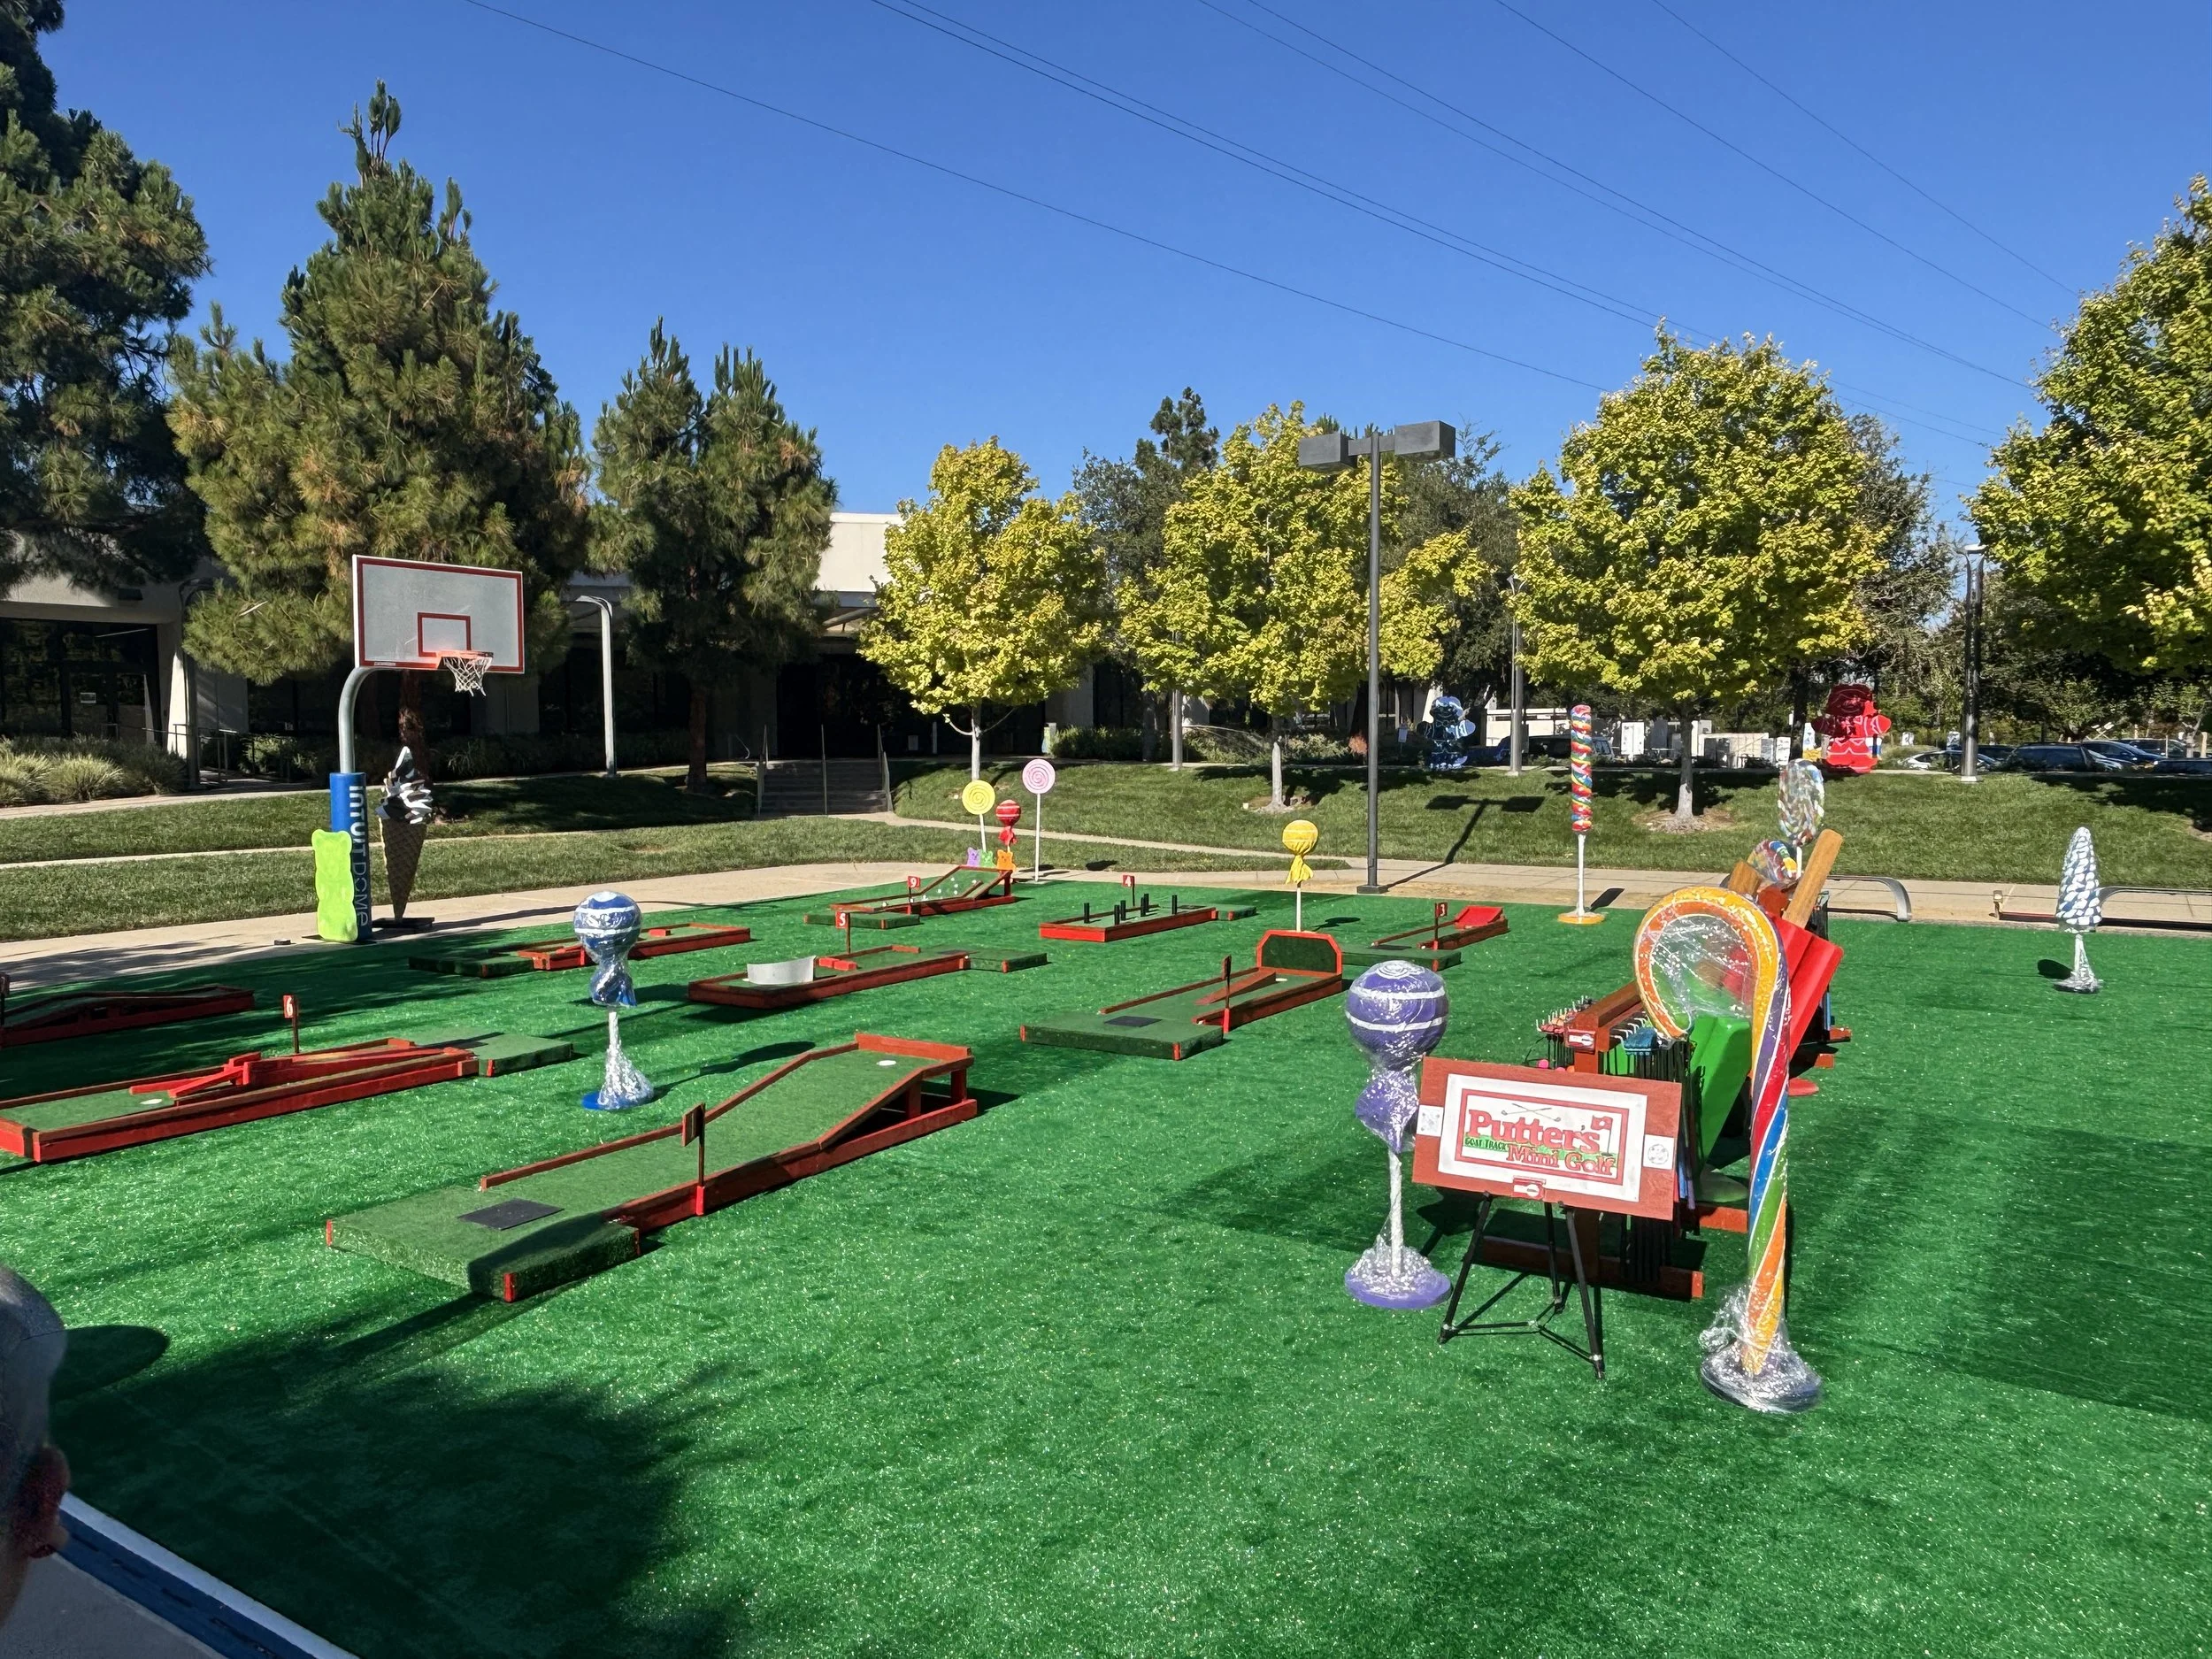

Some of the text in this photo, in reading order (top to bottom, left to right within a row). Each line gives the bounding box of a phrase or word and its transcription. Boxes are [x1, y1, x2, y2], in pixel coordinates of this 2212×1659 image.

[910, 877, 917, 888] 9
[286, 996, 293, 1017] 6
[1465, 1109, 1601, 1154] Putter's
[1506, 1144, 1617, 1175] Mini Golf
